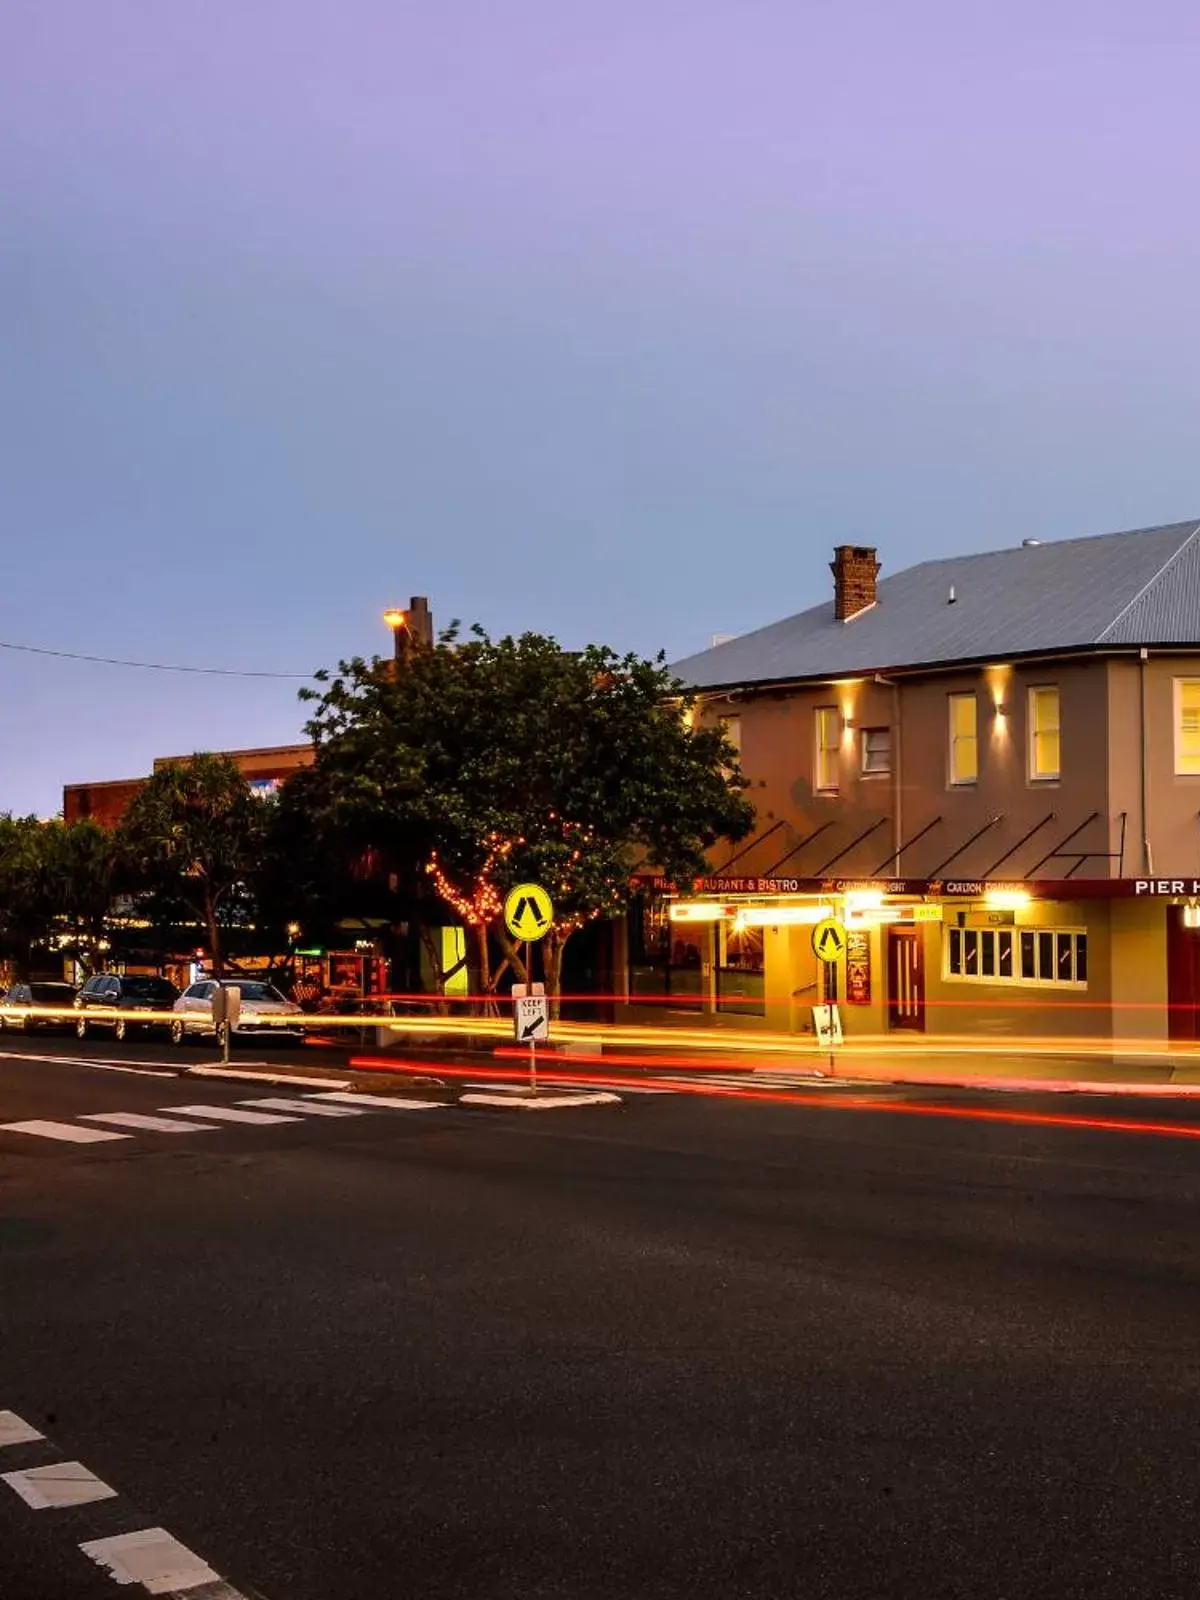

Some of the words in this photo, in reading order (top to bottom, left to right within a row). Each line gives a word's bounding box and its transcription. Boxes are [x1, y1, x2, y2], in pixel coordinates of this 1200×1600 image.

[757, 879, 798, 891] BISTRO
[946, 882, 982, 893] CARLTON
[1135, 880, 1185, 894] PIER
[522, 999, 542, 1007] KEEP
[523, 1008, 542, 1016] LEFT
